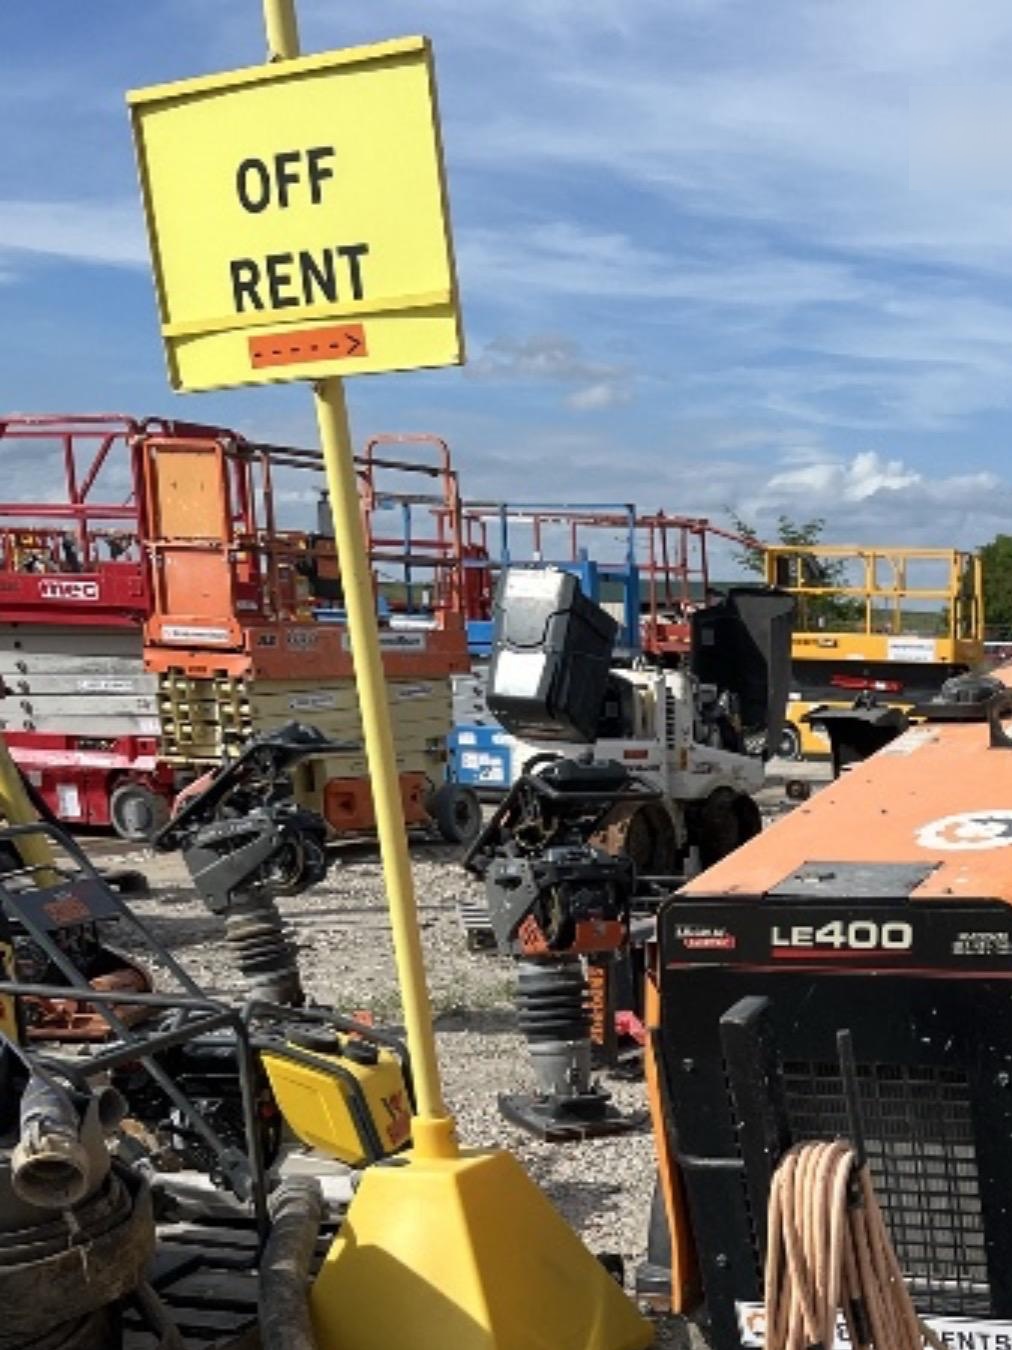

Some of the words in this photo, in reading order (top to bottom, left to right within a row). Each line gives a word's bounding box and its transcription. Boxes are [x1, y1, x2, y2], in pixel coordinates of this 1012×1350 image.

[236, 146, 335, 214] OFF
[230, 243, 369, 313] RENT
[771, 920, 912, 949] LE400
